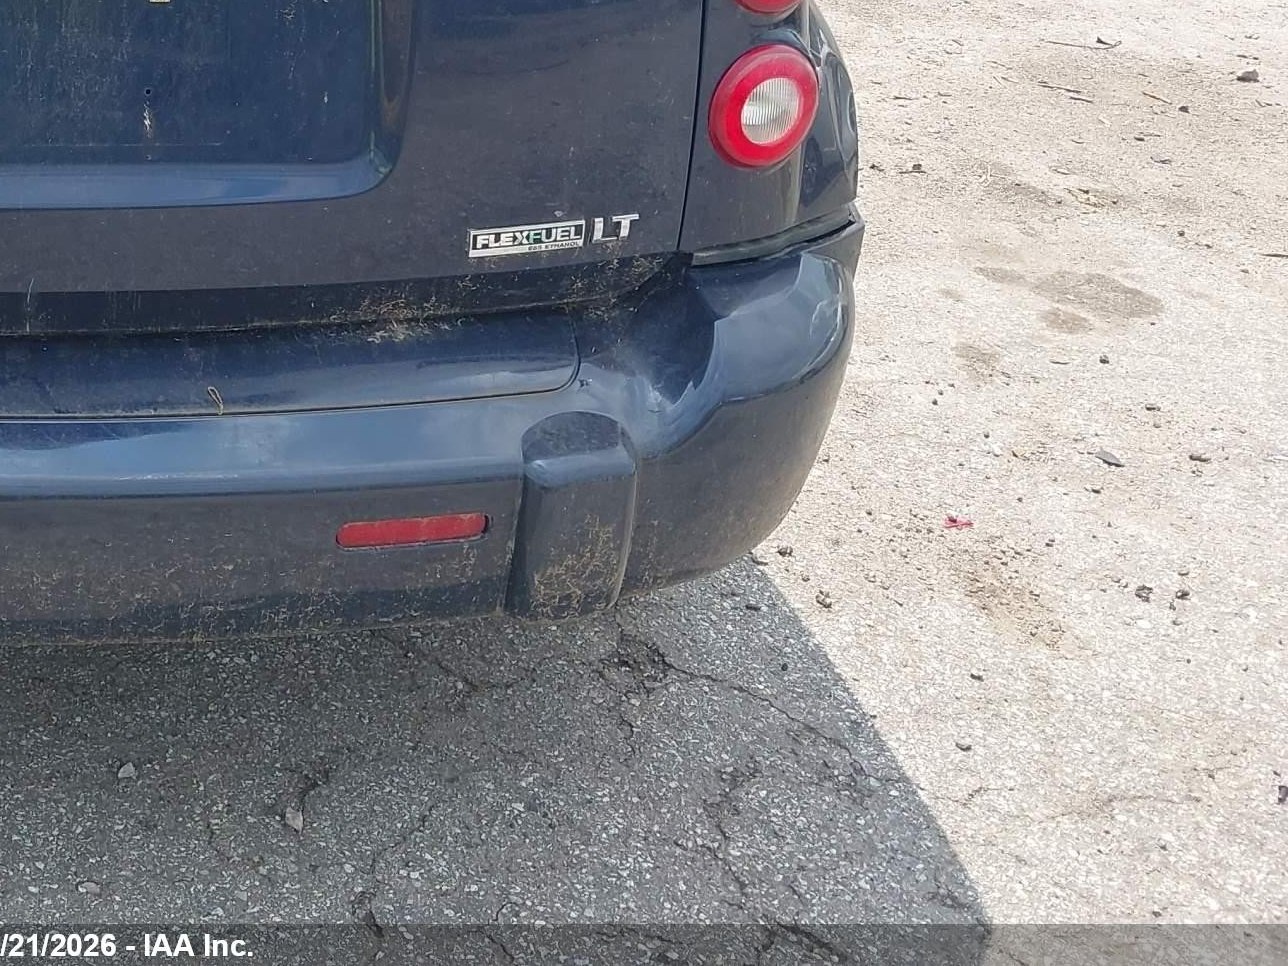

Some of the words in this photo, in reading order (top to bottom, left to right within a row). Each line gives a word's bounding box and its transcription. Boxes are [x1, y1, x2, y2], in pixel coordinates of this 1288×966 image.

[476, 226, 581, 248] FLEXFUEL
[591, 213, 640, 244] LT
[544, 240, 580, 250] ETHANOL
